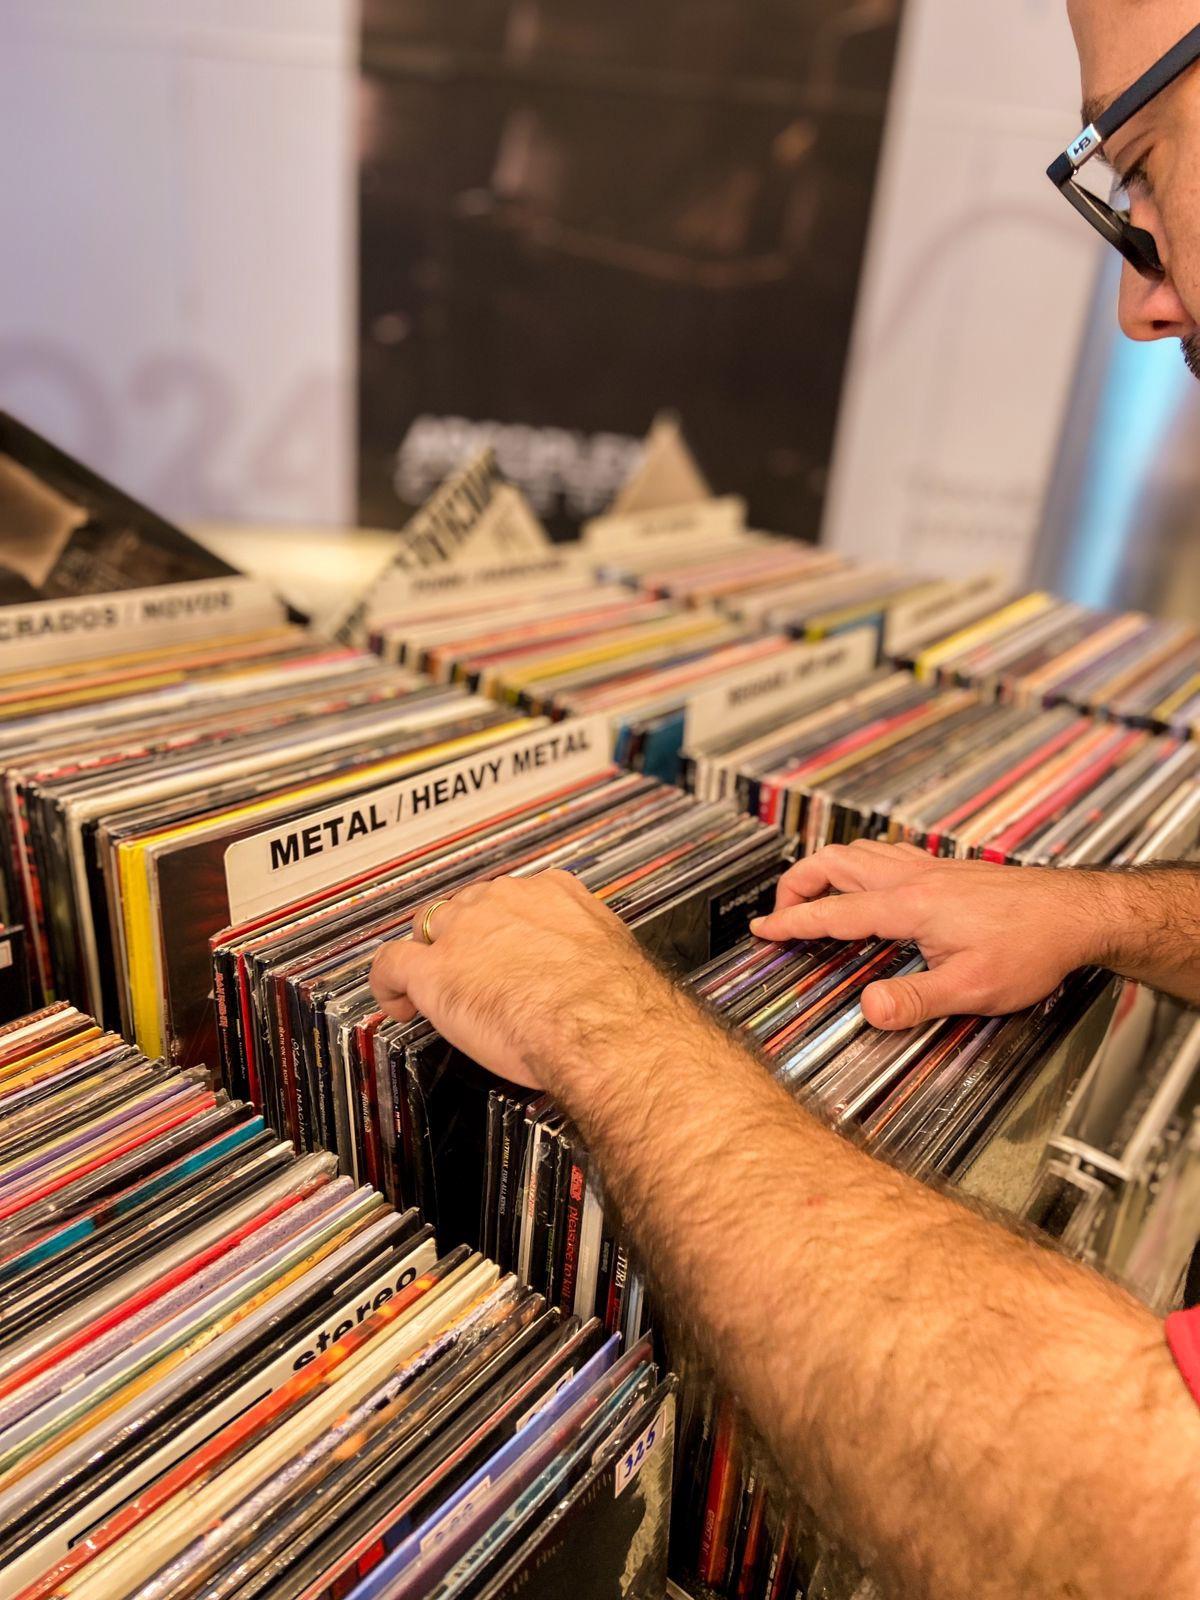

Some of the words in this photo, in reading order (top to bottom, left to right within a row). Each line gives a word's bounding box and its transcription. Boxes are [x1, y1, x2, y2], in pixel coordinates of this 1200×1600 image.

[270, 804, 387, 870] METAL
[411, 757, 504, 816] HEAVY
[511, 729, 588, 774] METAL
[293, 1266, 417, 1372] stereo
[624, 1414, 662, 1479] 325
